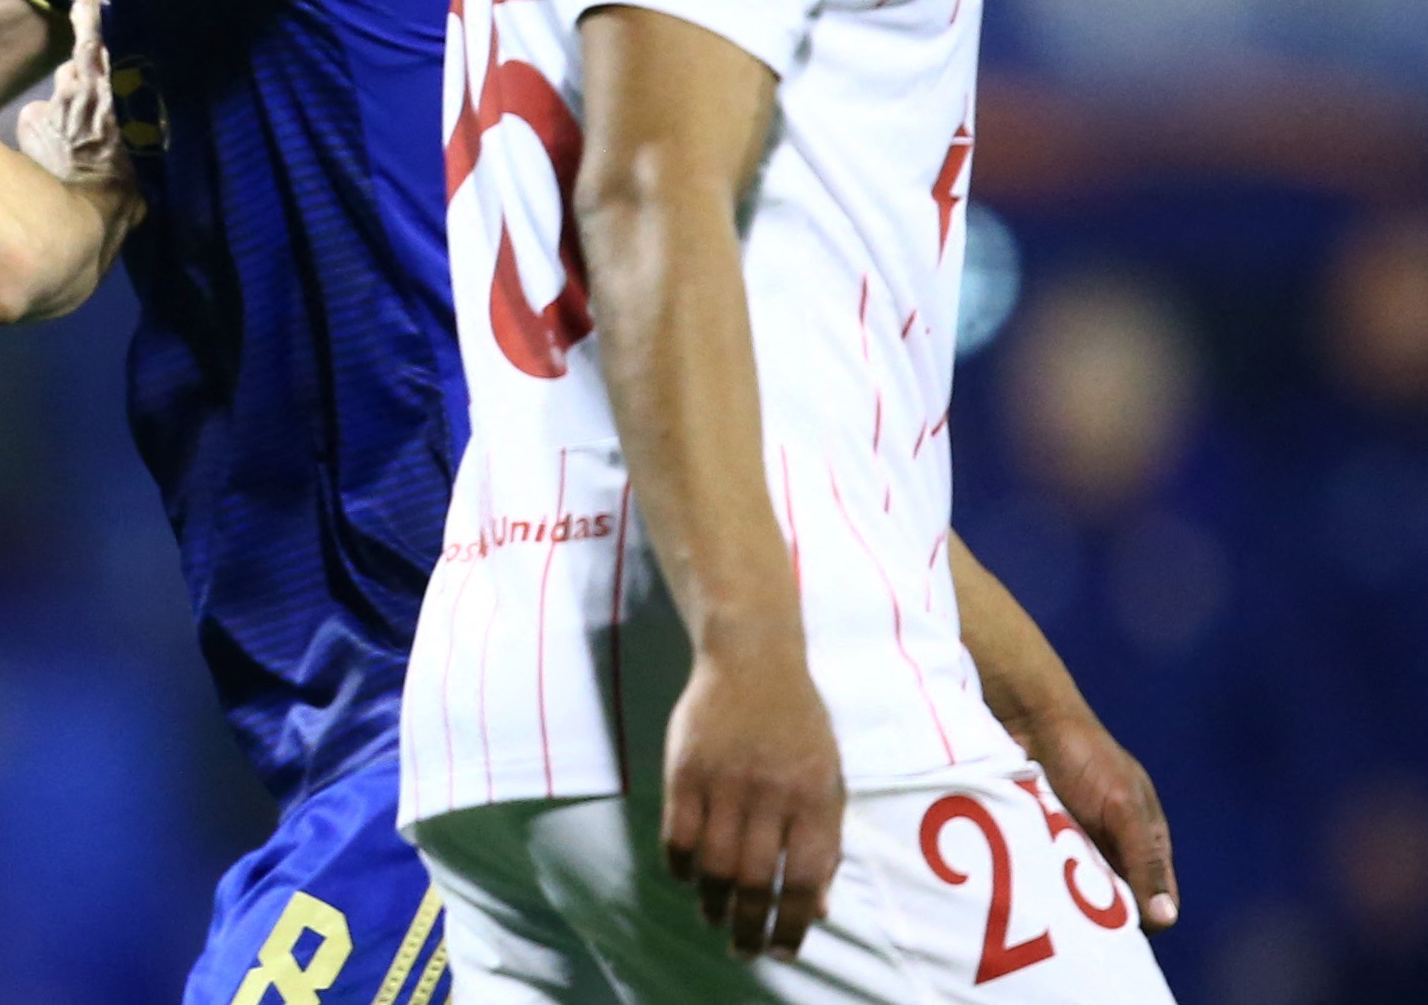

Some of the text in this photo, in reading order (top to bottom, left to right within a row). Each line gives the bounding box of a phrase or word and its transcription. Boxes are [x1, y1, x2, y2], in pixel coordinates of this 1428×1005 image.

[491, 512, 613, 547] Unidas
[919, 777, 1129, 986] 25
[228, 889, 354, 1005] 8
